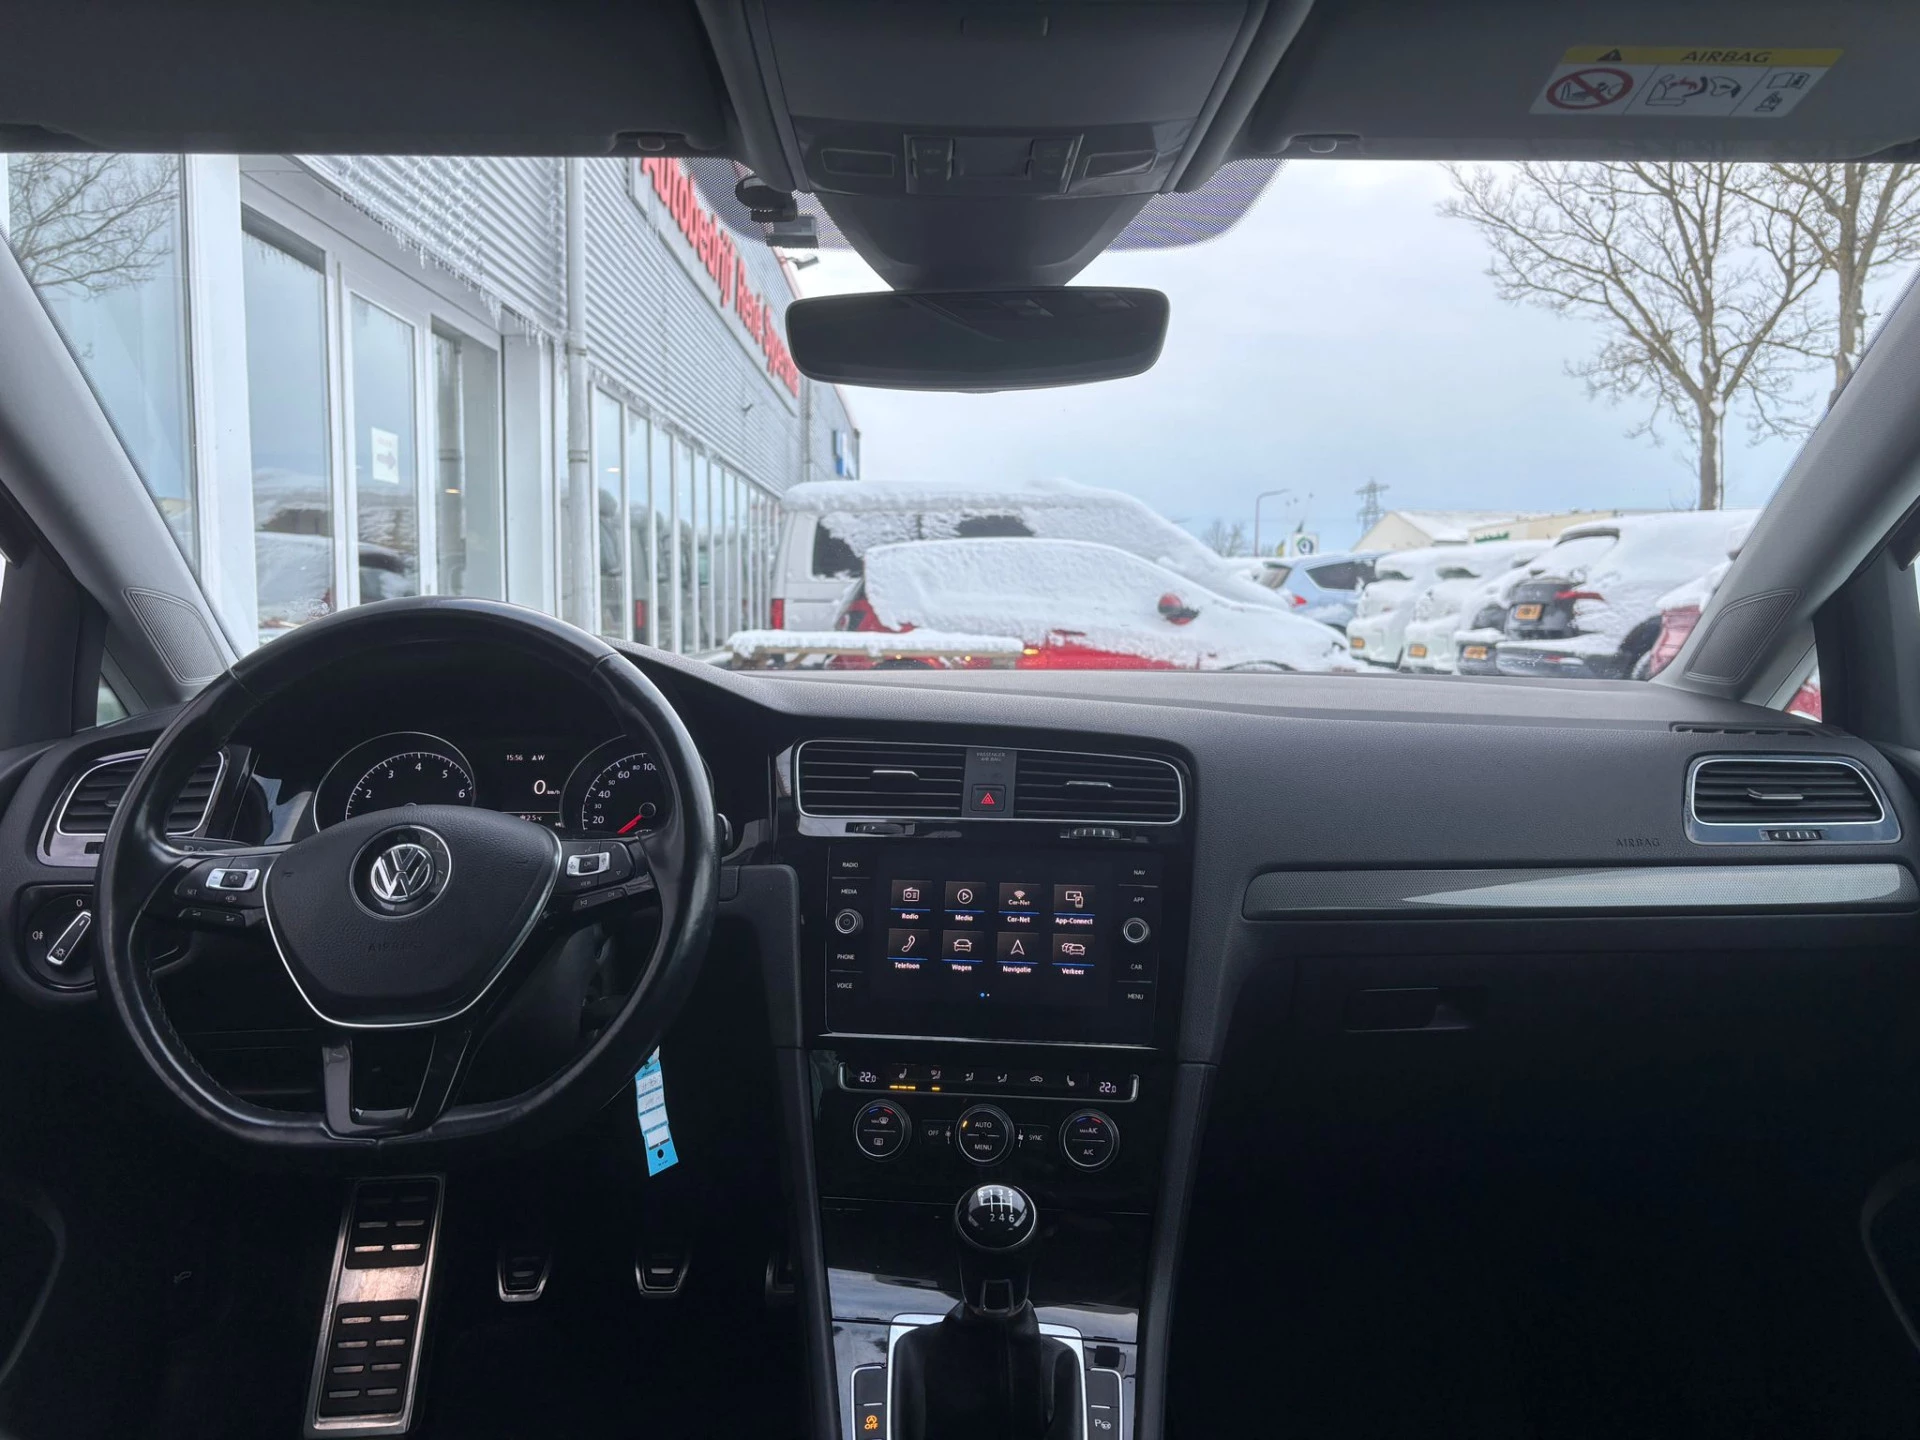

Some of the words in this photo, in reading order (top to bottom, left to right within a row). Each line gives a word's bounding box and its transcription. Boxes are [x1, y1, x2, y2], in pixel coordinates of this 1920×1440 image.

[1682, 51, 1771, 63] AIRBAG
[415, 762, 422, 771] 4
[388, 769, 394, 779] 3
[442, 769, 448, 779] 5
[618, 771, 630, 779] 60
[533, 779, 547, 795] 0
[365, 789, 372, 799] 2
[458, 789, 466, 798] 6
[598, 790, 611, 799] 40
[593, 815, 605, 824] 20
[1055, 917, 1093, 925] App-Connect
[951, 963, 972, 972] Wagen
[1002, 965, 1032, 974] Navigatie
[1062, 967, 1085, 975] Verkeer
[989, 1213, 996, 1222] 2
[998, 1213, 1005, 1222] 4
[1008, 1214, 1015, 1223] 6
